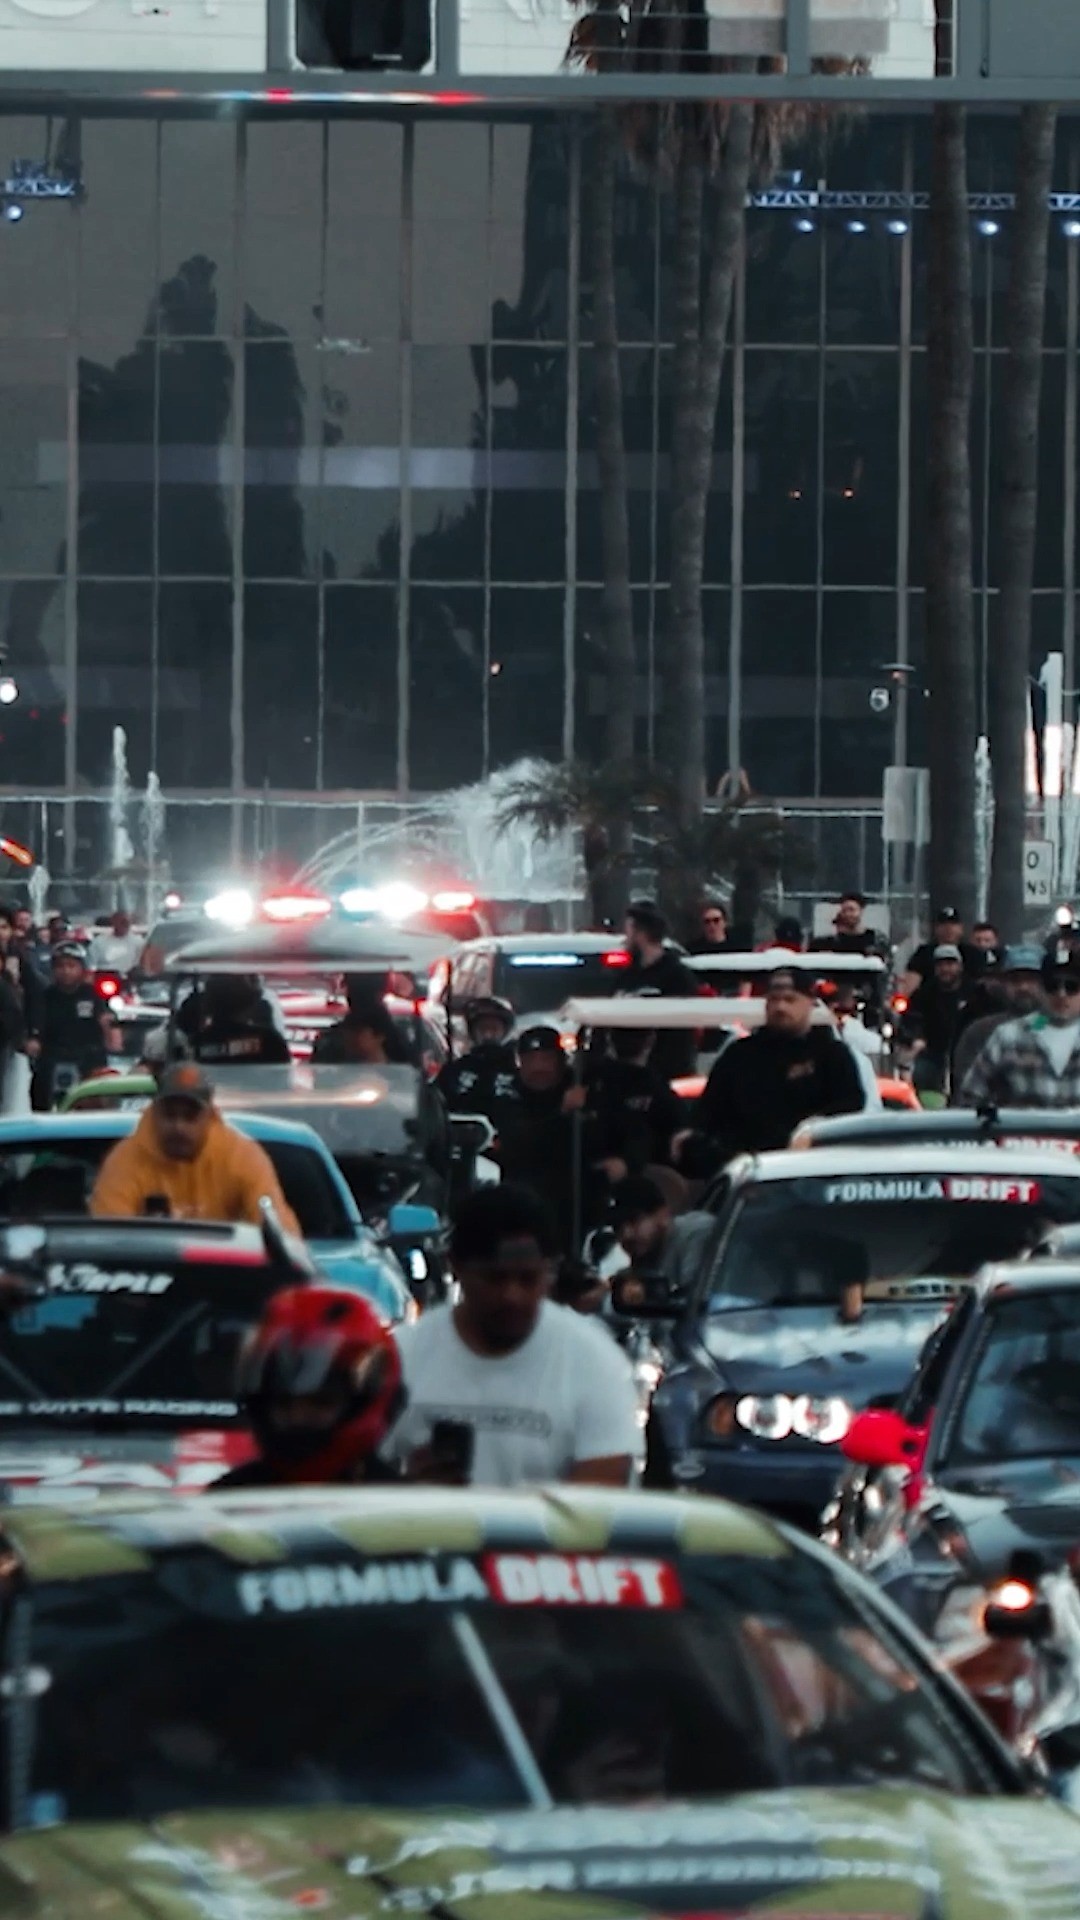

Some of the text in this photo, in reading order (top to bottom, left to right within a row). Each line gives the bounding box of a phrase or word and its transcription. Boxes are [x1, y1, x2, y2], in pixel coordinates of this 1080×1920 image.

[825, 1177, 1036, 1203] FORMULA DRIFT
[236, 1552, 668, 1615] FORMULA DRIFT
